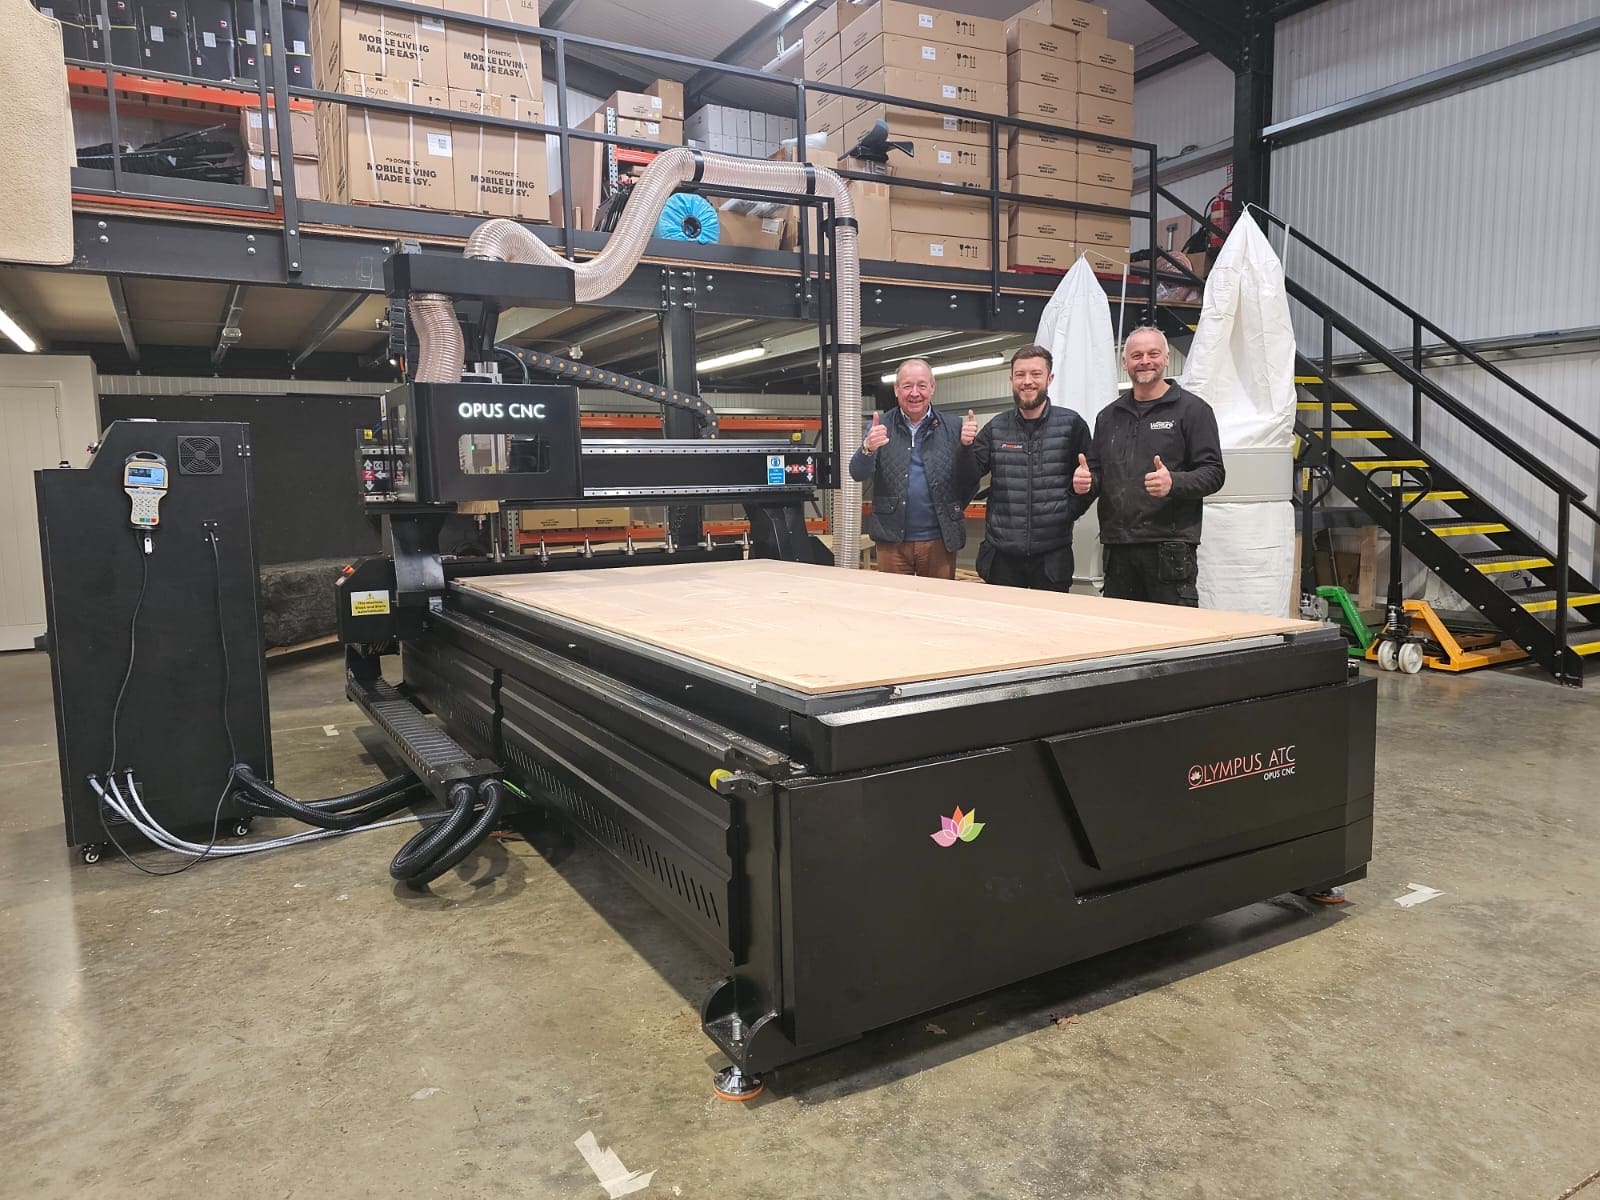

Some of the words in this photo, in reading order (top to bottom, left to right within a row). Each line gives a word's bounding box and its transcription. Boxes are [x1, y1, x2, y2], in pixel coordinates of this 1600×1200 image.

[498, 67, 523, 78] EASY.
[375, 172, 403, 183] MADE
[405, 167, 437, 178] LVING
[458, 402, 504, 418] OPUS
[508, 403, 546, 418] CNC
[1188, 752, 1263, 787] OLYMPUS
[1268, 745, 1296, 767] ATC
[1263, 770, 1281, 781] OPUS
[1281, 766, 1296, 776] CNC
